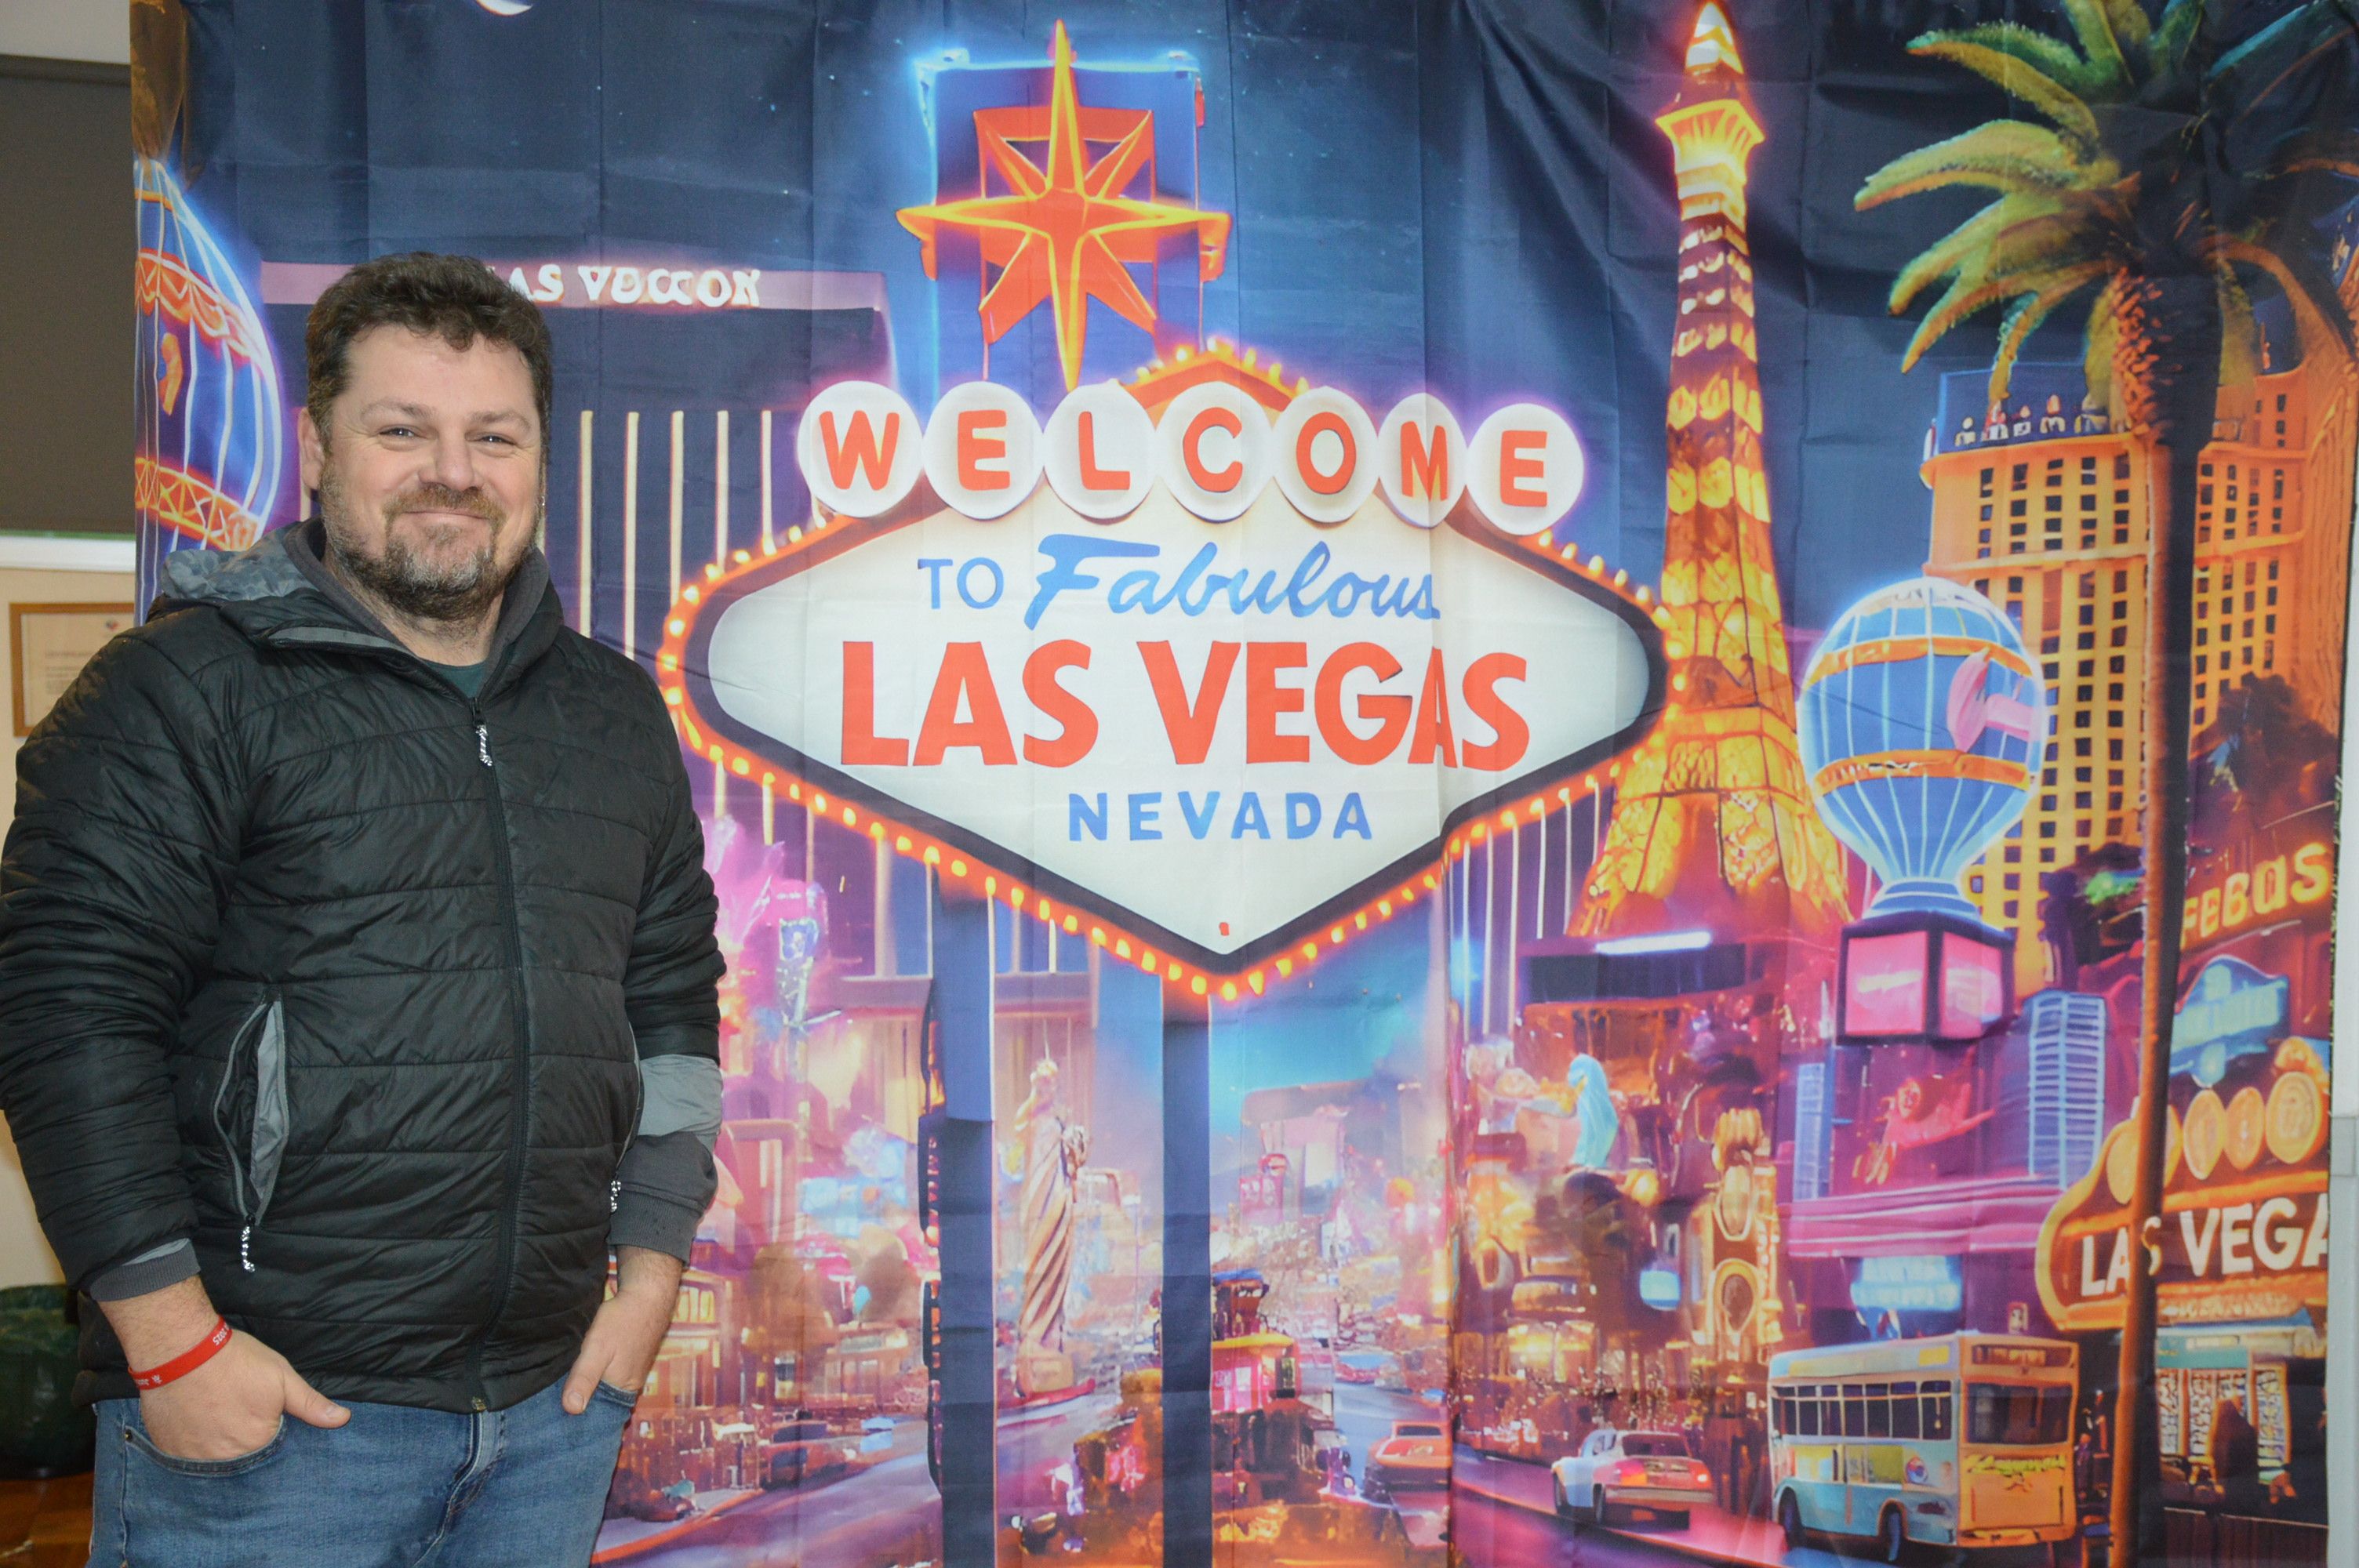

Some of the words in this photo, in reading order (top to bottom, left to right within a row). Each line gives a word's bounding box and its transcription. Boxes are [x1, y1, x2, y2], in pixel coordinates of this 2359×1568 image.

[485, 264, 565, 302] AS
[819, 406, 1548, 508] WELCOME
[917, 557, 1005, 609] TO
[1023, 533, 1441, 630] Fabulous
[841, 639, 1099, 768] LAS
[1136, 640, 1531, 771] VEGAS
[1067, 790, 1373, 843] NEVADA
